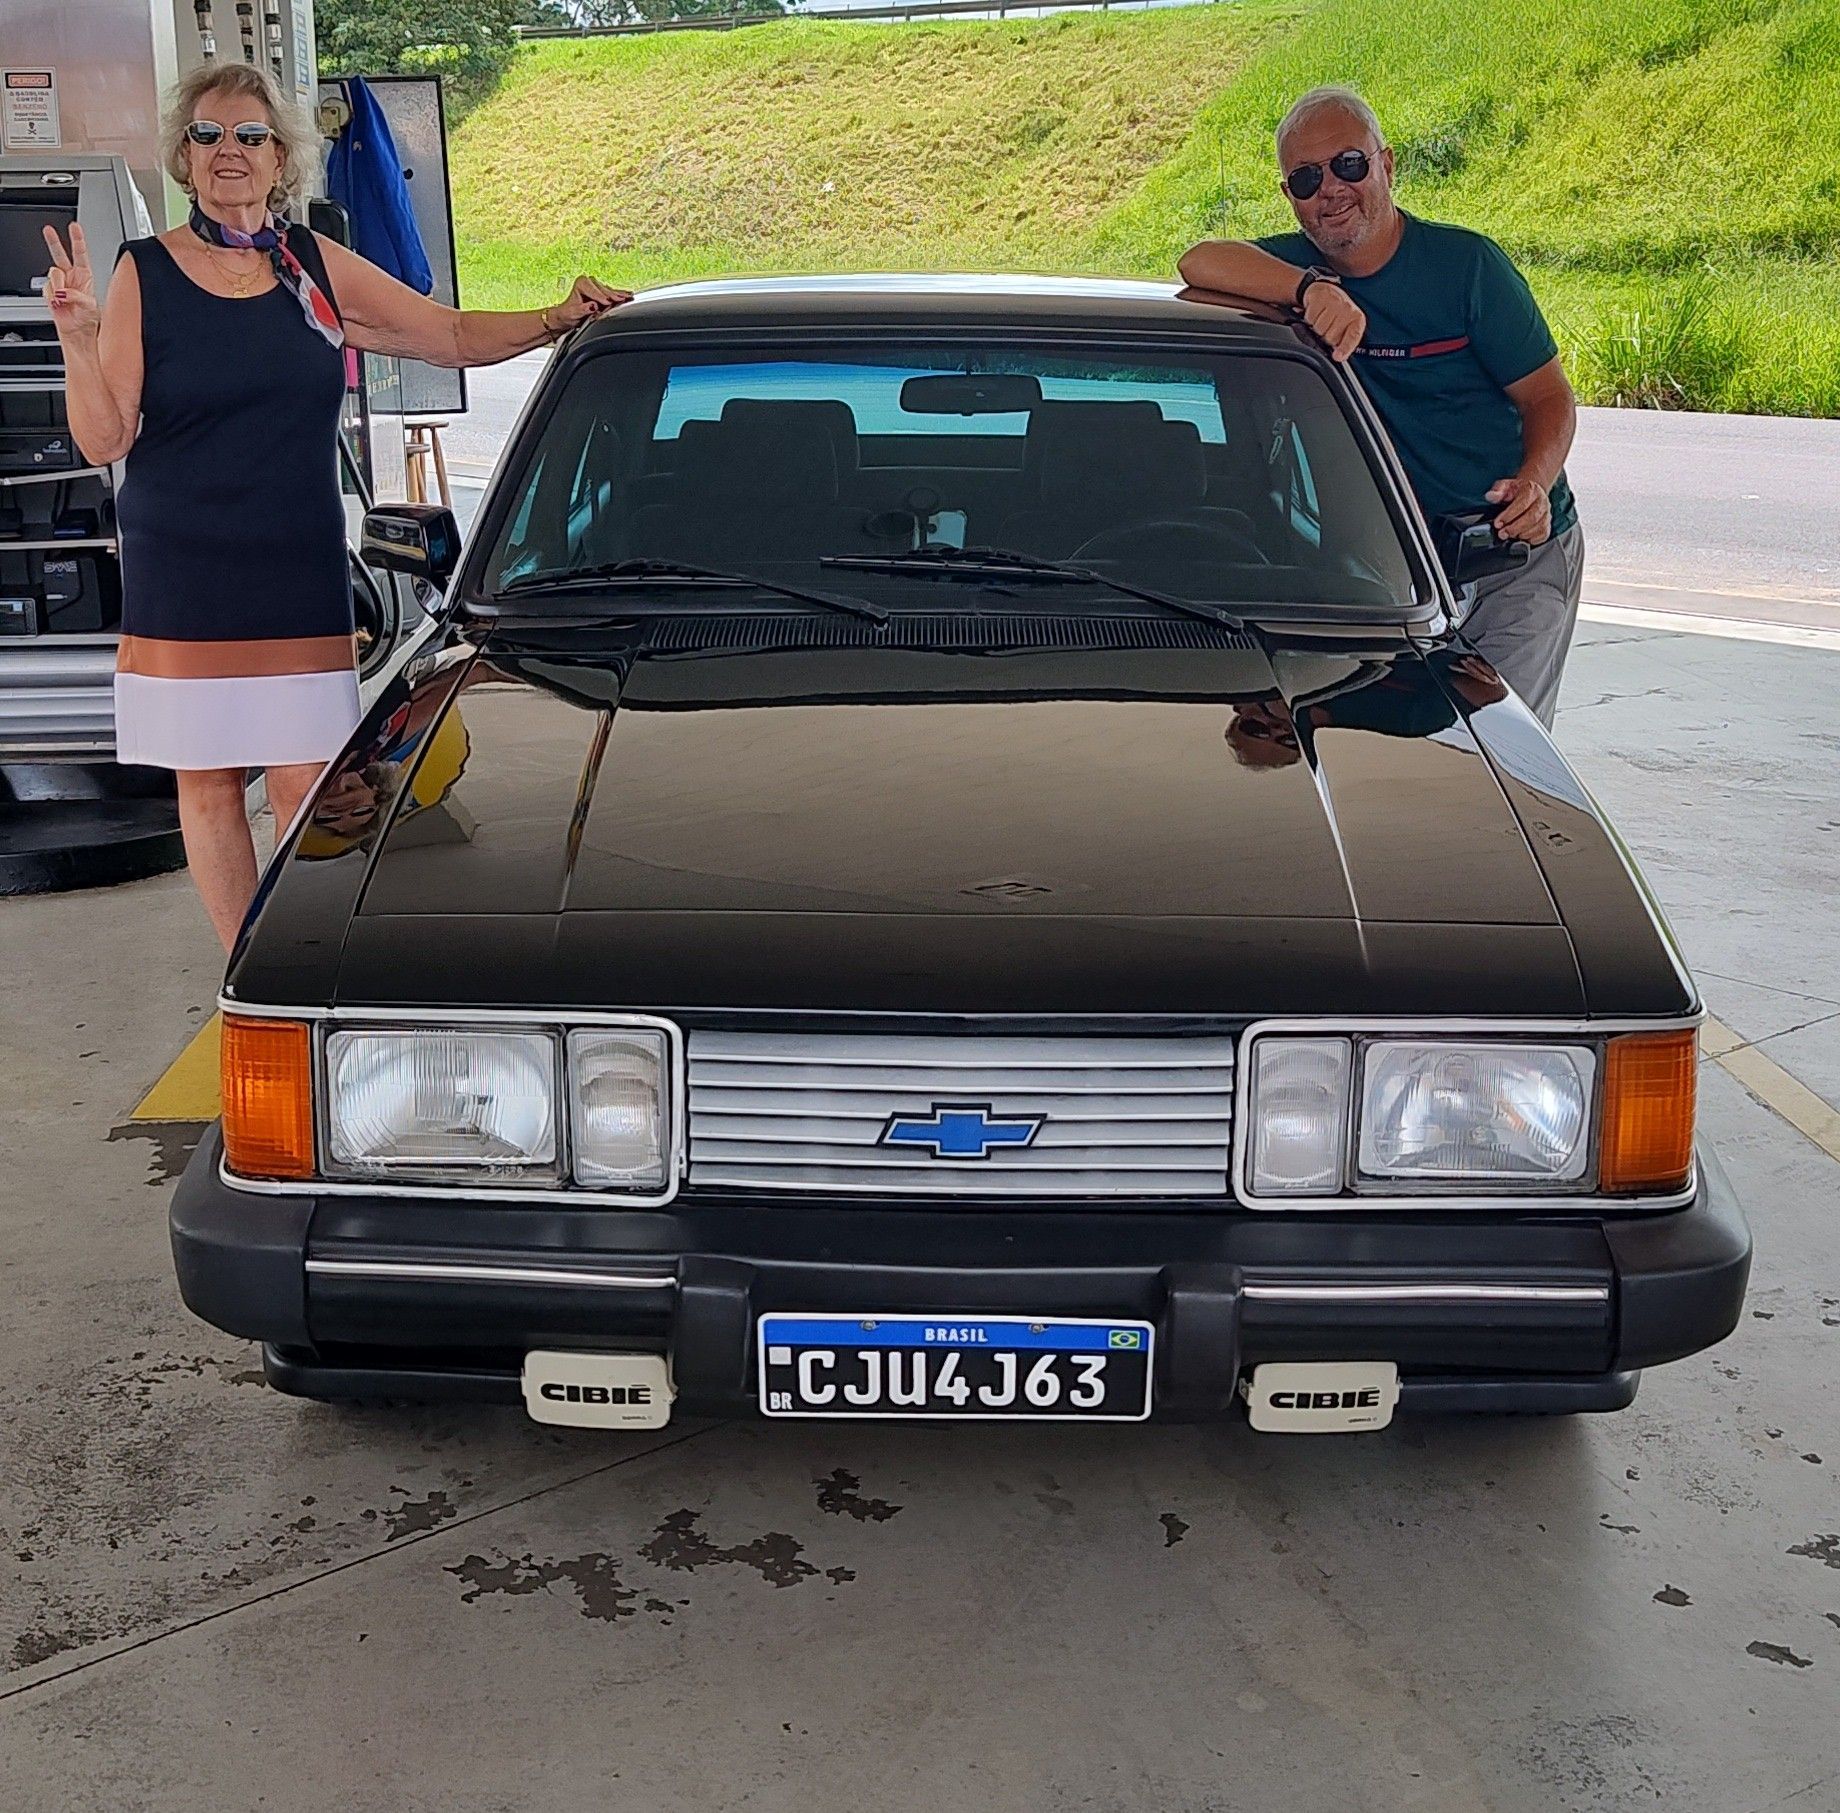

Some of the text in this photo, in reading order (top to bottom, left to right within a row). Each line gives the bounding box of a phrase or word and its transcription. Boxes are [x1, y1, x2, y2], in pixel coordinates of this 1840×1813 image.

[924, 1327, 988, 1343] BRASIL
[799, 1350, 1107, 1407] CJU4J63
[770, 1392, 793, 1411] BR
